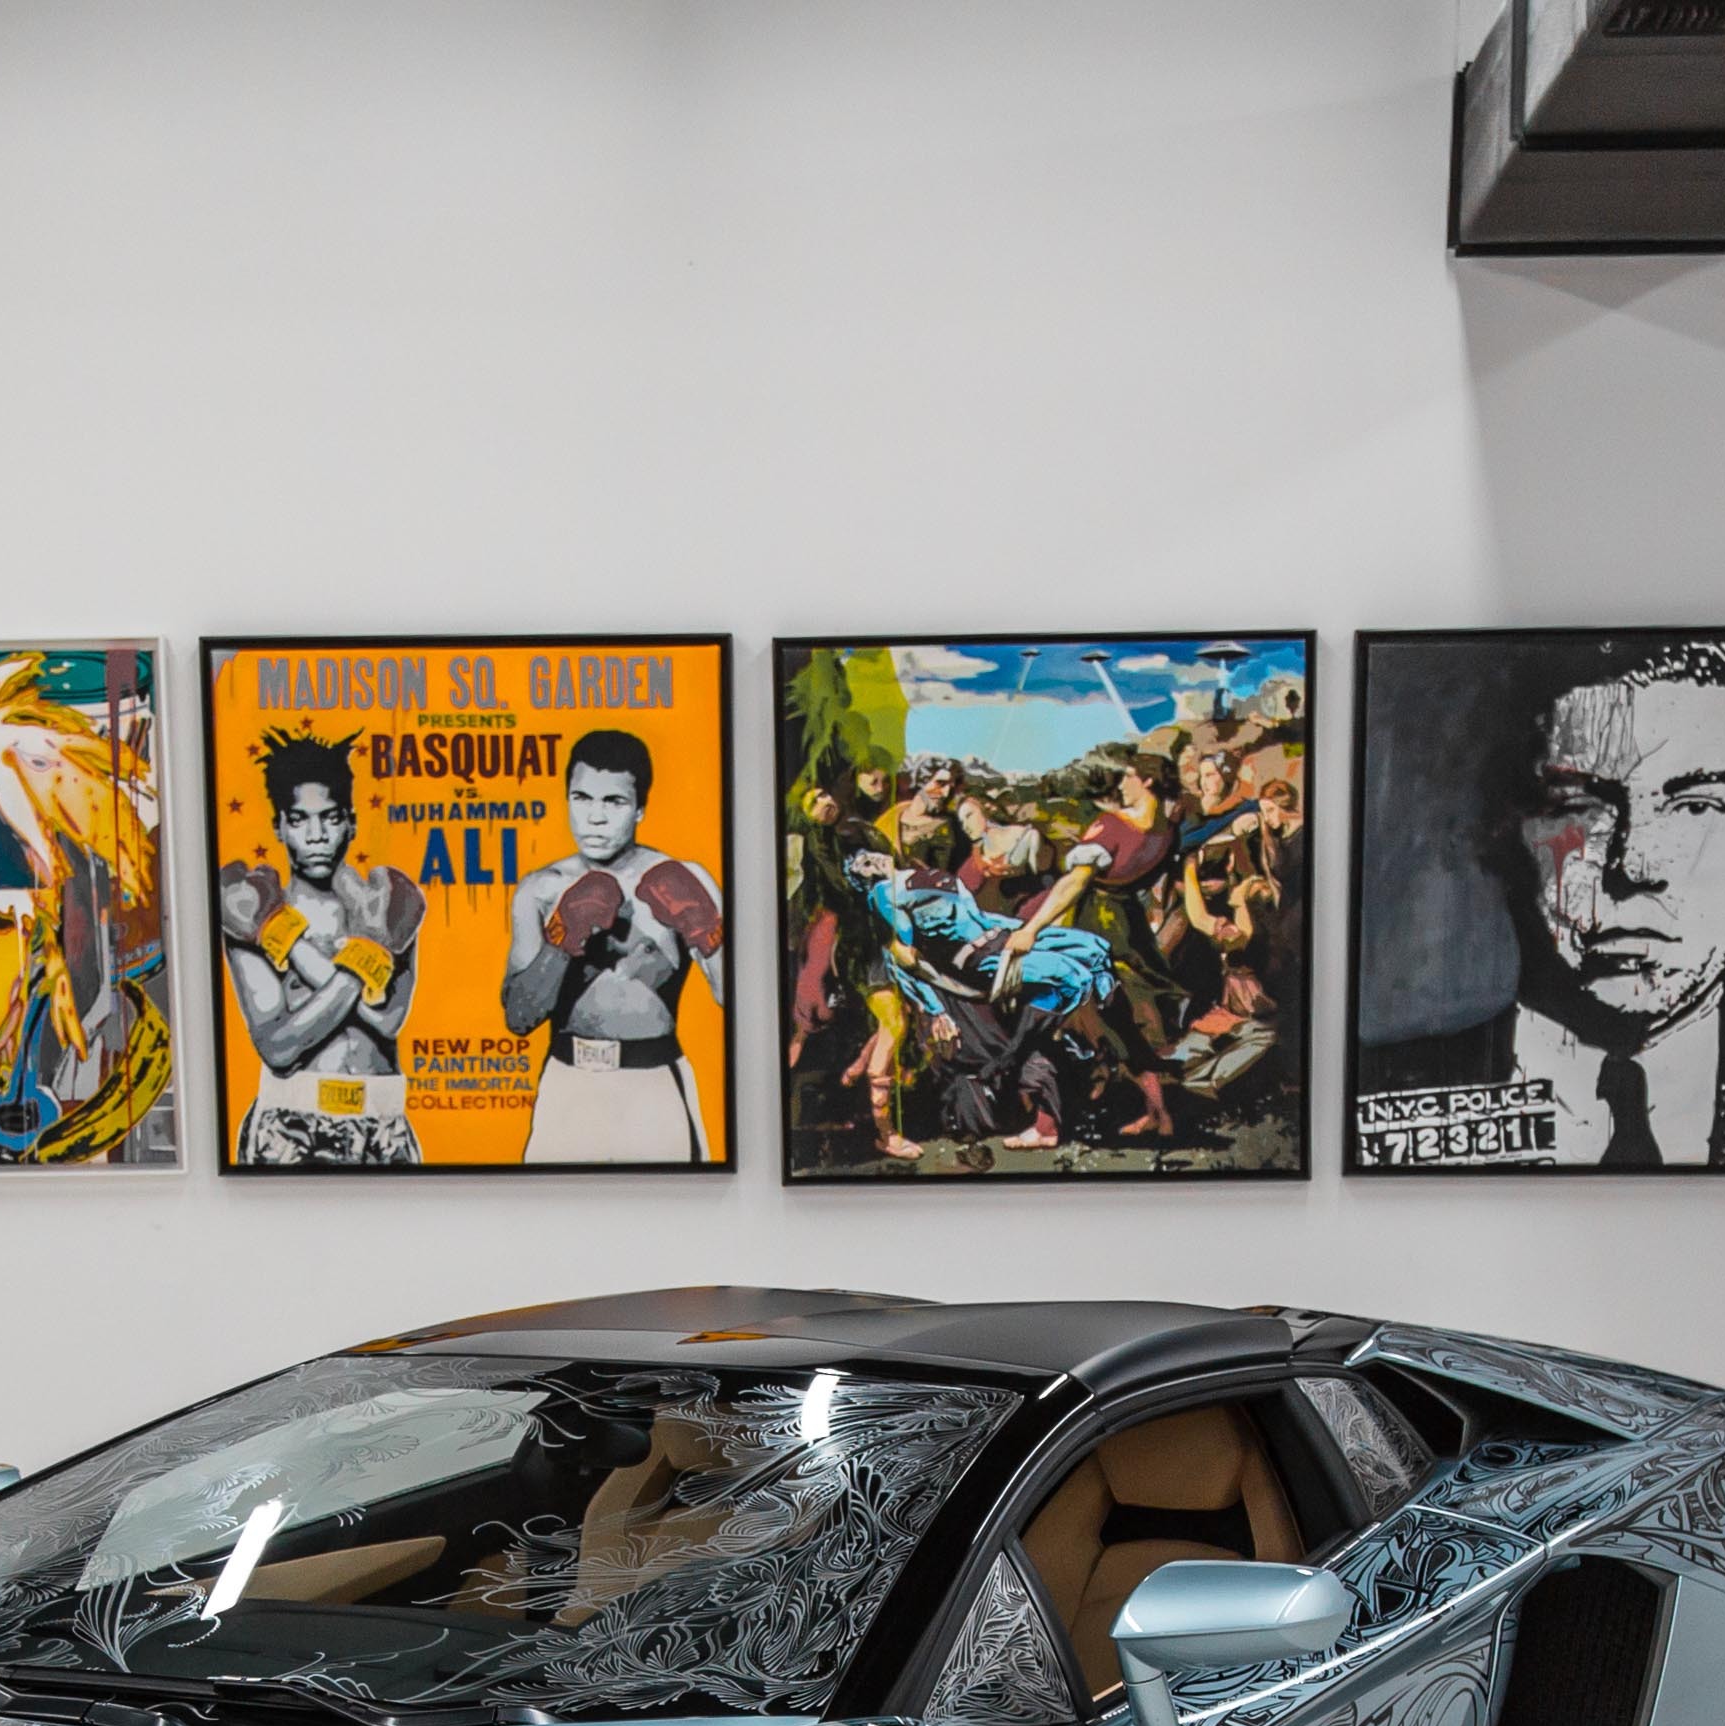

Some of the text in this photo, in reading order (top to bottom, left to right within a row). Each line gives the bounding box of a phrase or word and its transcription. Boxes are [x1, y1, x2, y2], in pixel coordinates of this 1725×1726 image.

[258, 655, 674, 710] MADISON SQ. GARDEN
[418, 713, 517, 728] PRESENTS
[371, 732, 562, 785] BASQUIAT
[388, 801, 547, 822] MUHAMMAD
[419, 828, 518, 886] ALI
[412, 1038, 530, 1055] NEW POP
[414, 1056, 530, 1073] PAINTINGS
[407, 1077, 533, 1092] THE IMMORTAL
[406, 1095, 533, 1110] COLLECTION
[1449, 1084, 1544, 1113] POLICE
